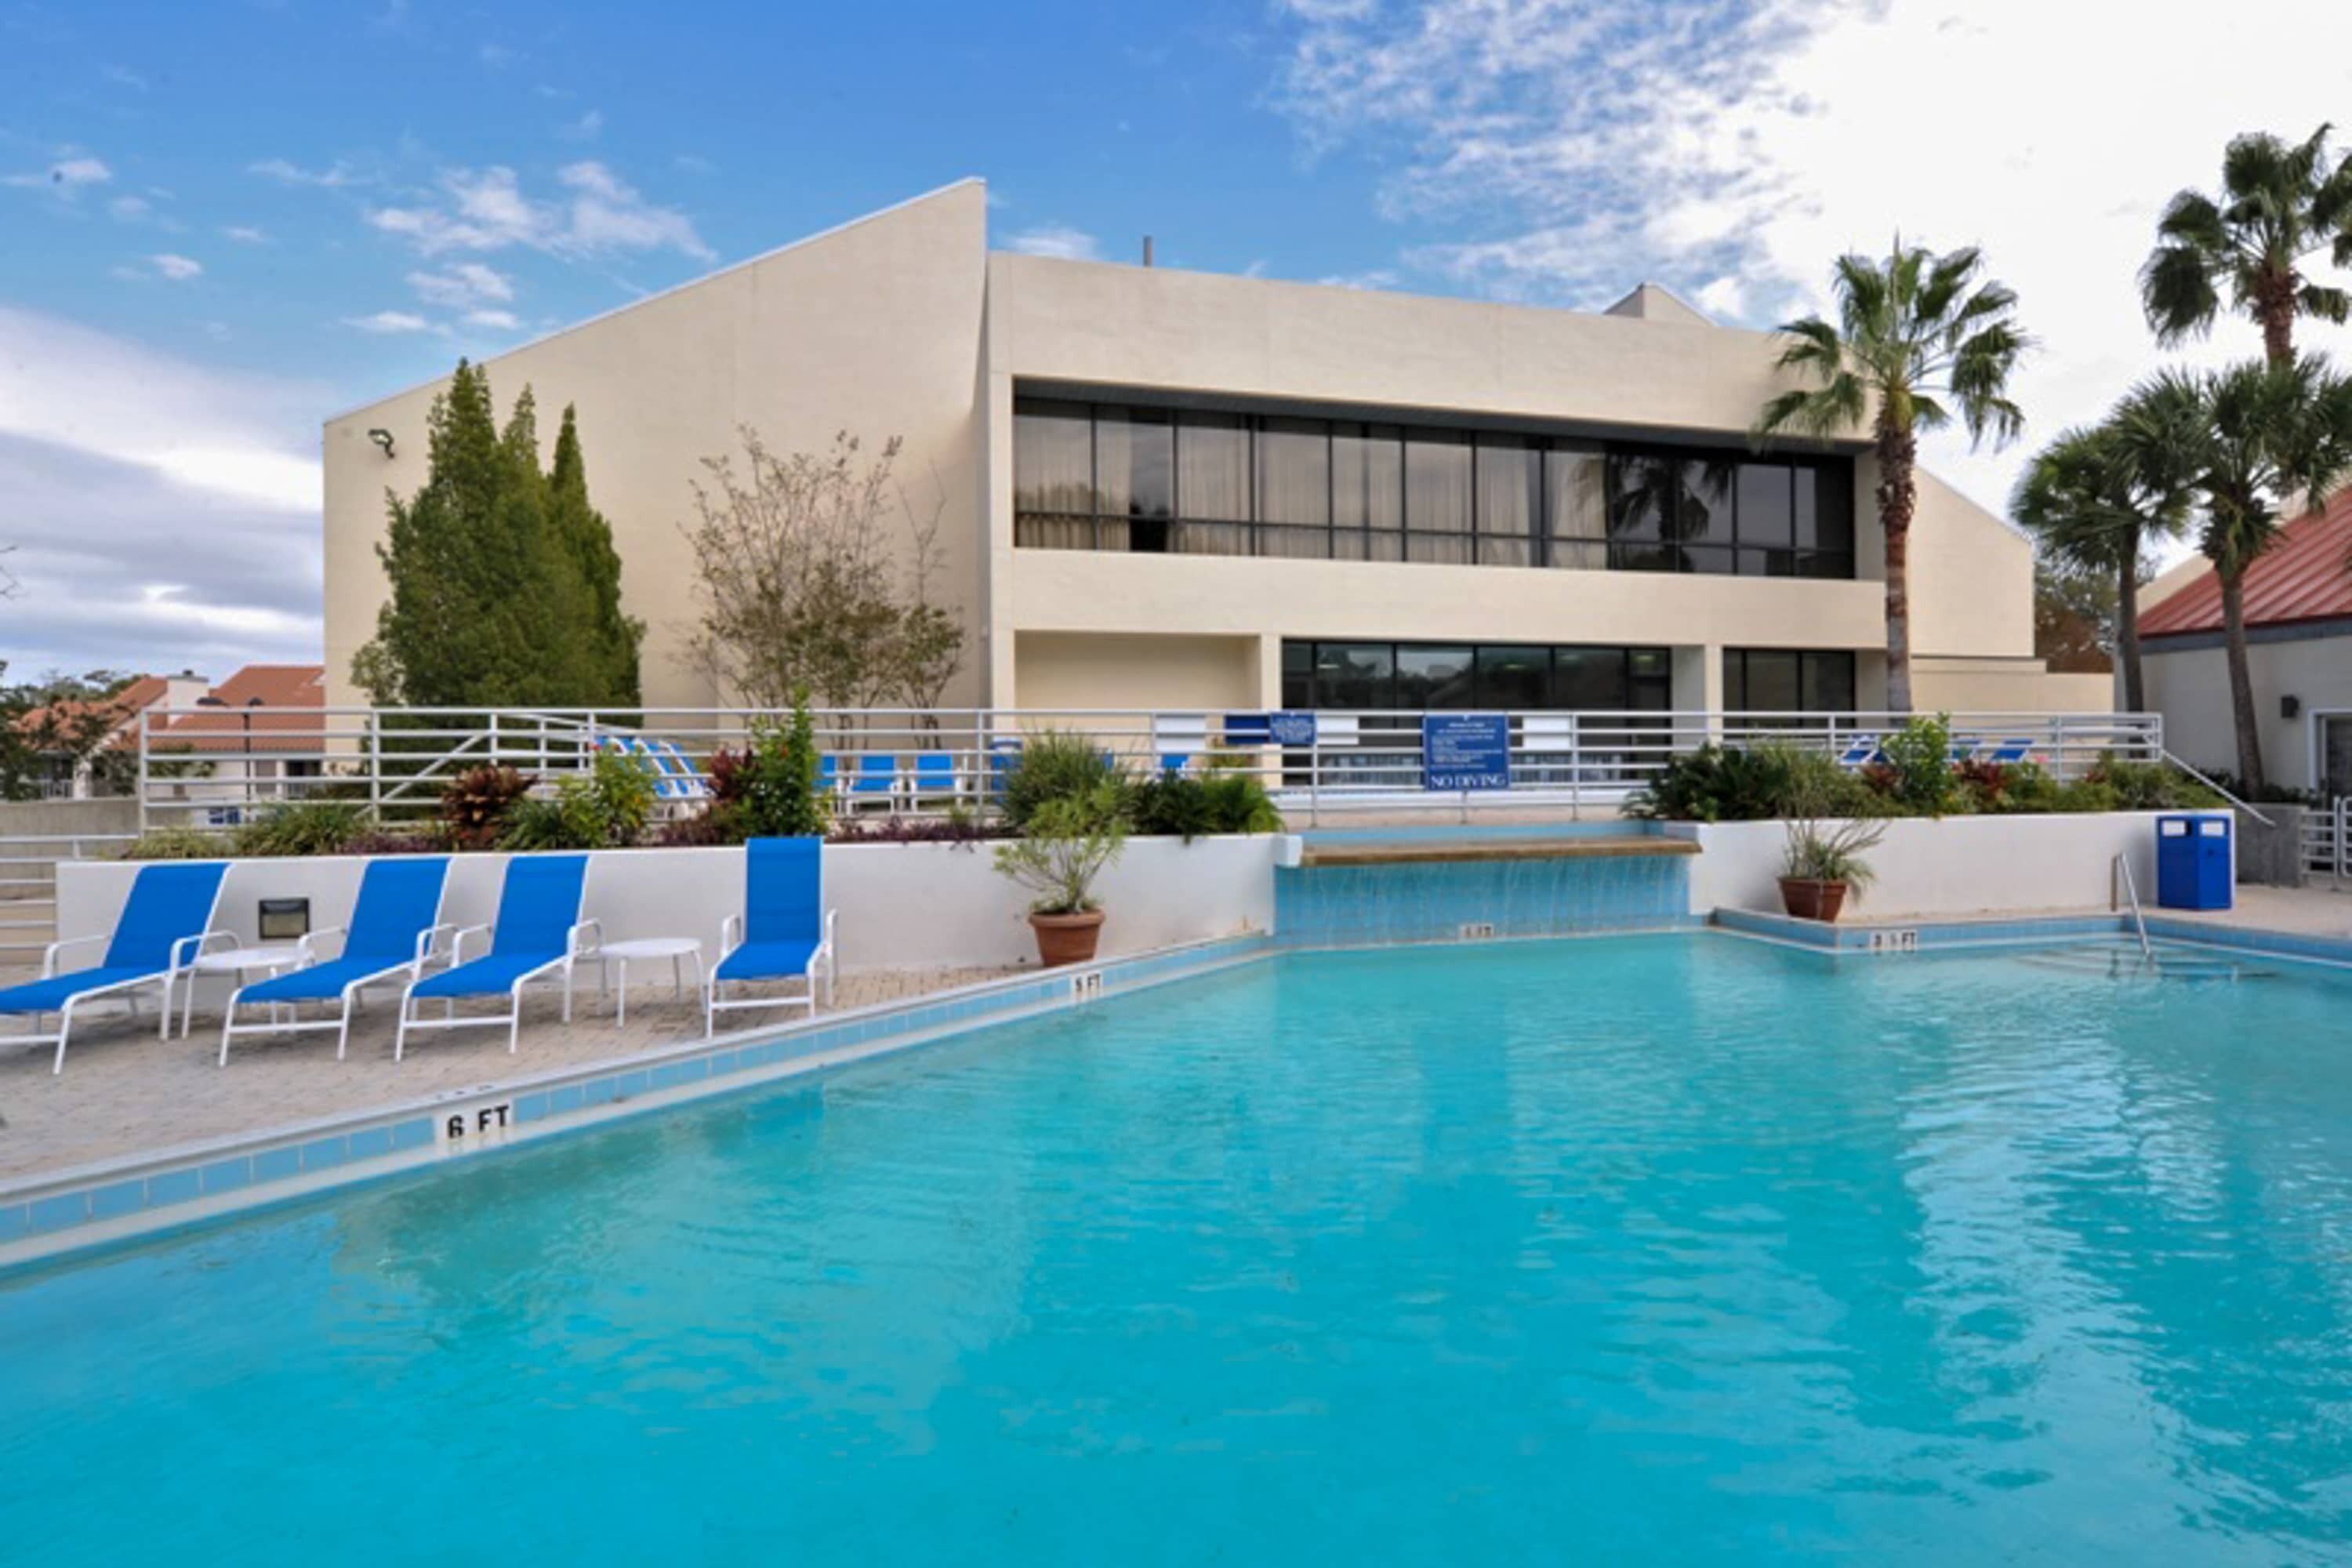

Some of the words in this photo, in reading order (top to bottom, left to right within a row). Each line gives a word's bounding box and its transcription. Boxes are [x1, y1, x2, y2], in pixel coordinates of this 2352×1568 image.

[1431, 775, 1454, 788] NO
[1455, 773, 1506, 788] DIVING
[1902, 932, 1915, 946] FT
[1087, 973, 1101, 990] FT
[447, 1114, 463, 1139] 6
[478, 1104, 509, 1133] FT
